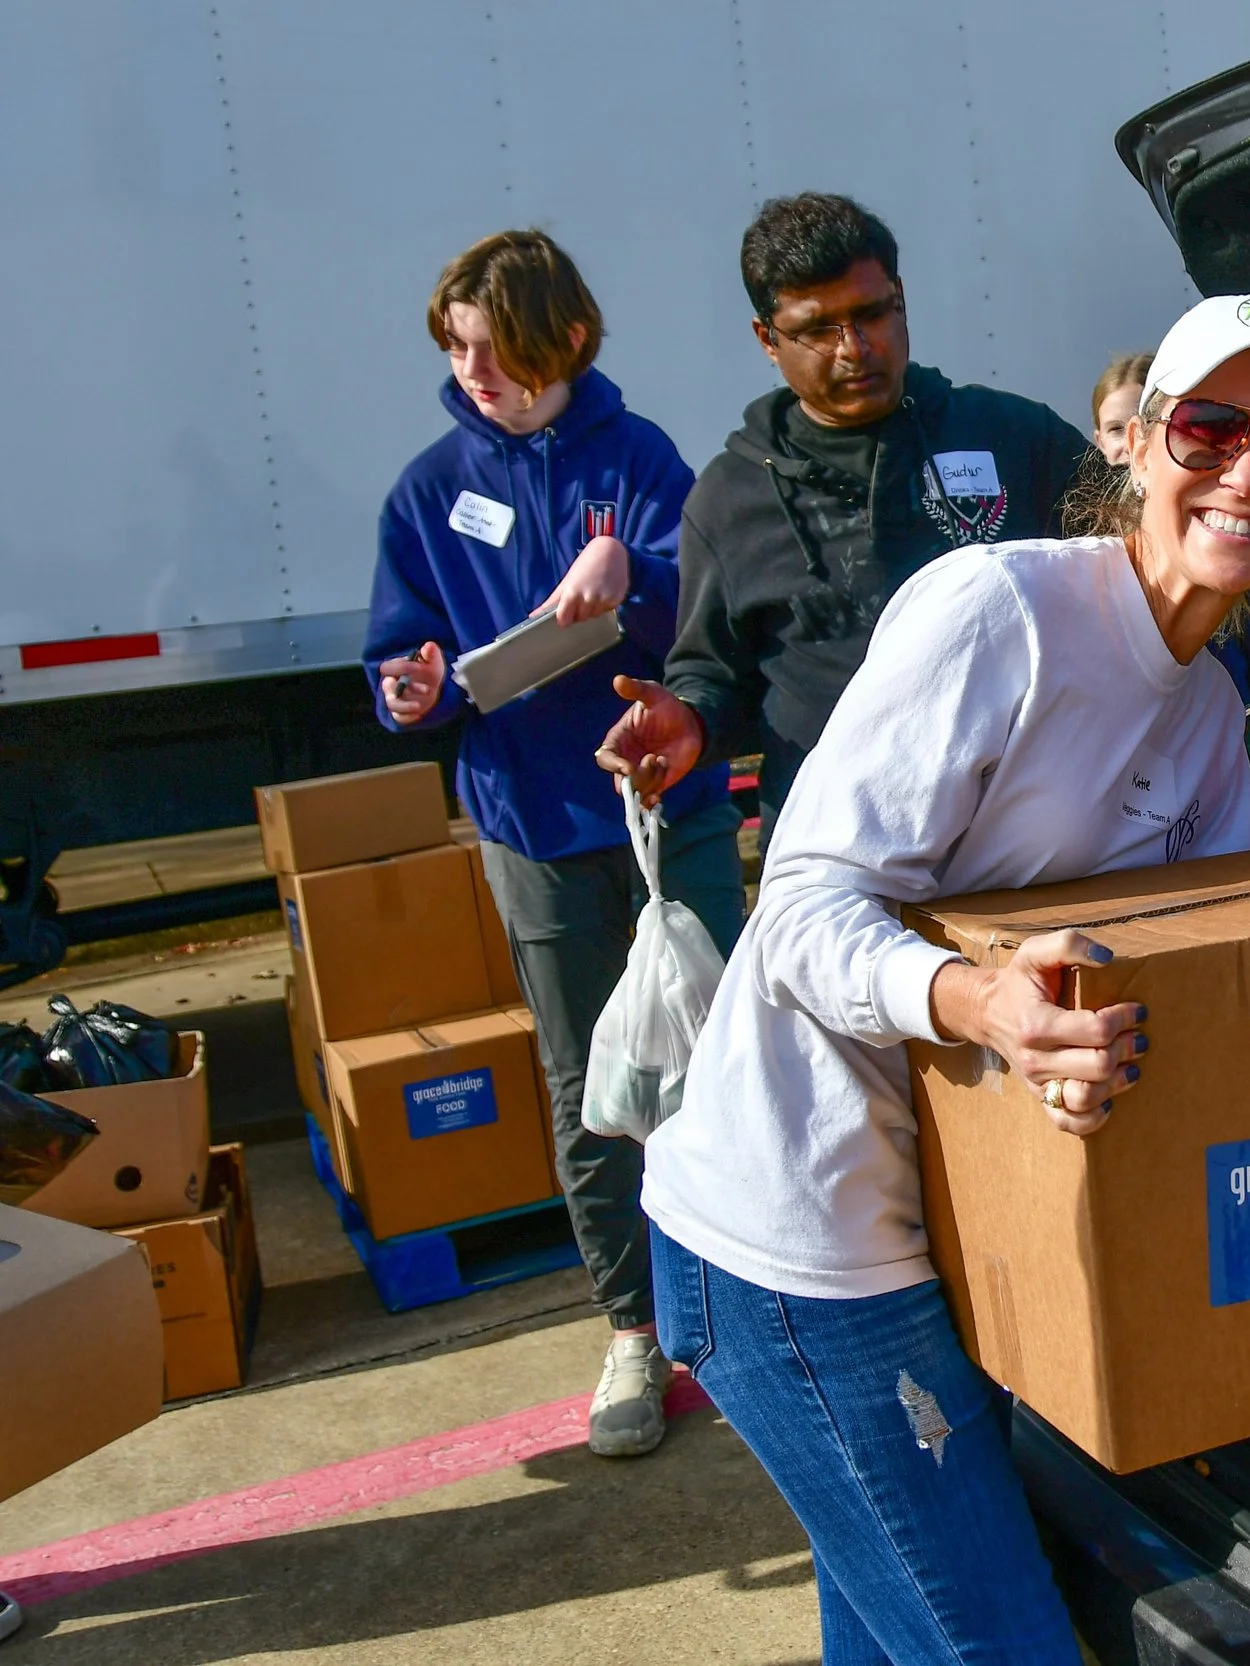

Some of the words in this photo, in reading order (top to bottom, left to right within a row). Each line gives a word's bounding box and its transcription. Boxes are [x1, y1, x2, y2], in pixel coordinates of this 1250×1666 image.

[1131, 771, 1151, 791] Katie
[1147, 811, 1166, 823] Team
[1165, 816, 1171, 824] A
[412, 1085, 441, 1105] grace
[449, 1076, 483, 1092] bridge
[436, 1100, 465, 1114] FOOD
